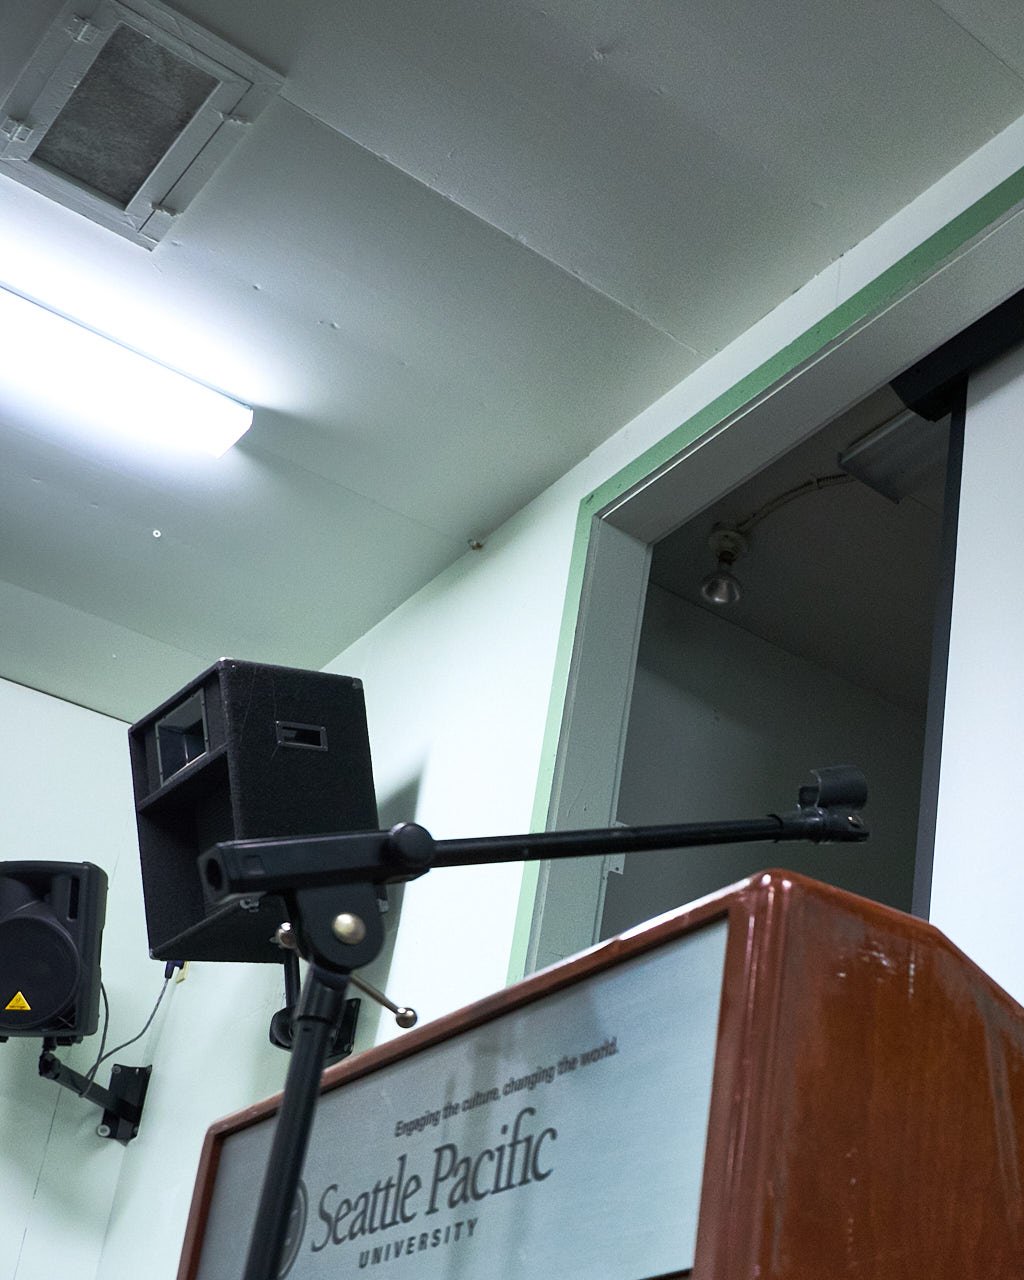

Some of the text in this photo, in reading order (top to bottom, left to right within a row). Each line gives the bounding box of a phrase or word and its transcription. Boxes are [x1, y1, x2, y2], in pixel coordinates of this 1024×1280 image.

[394, 1110, 441, 1137] Engaging
[442, 1101, 460, 1120] the
[502, 1066, 555, 1097] changing
[557, 1055, 578, 1076] the
[311, 1107, 557, 1252] Seattle Pacific
[358, 1217, 479, 1269] UNIVERSITY
